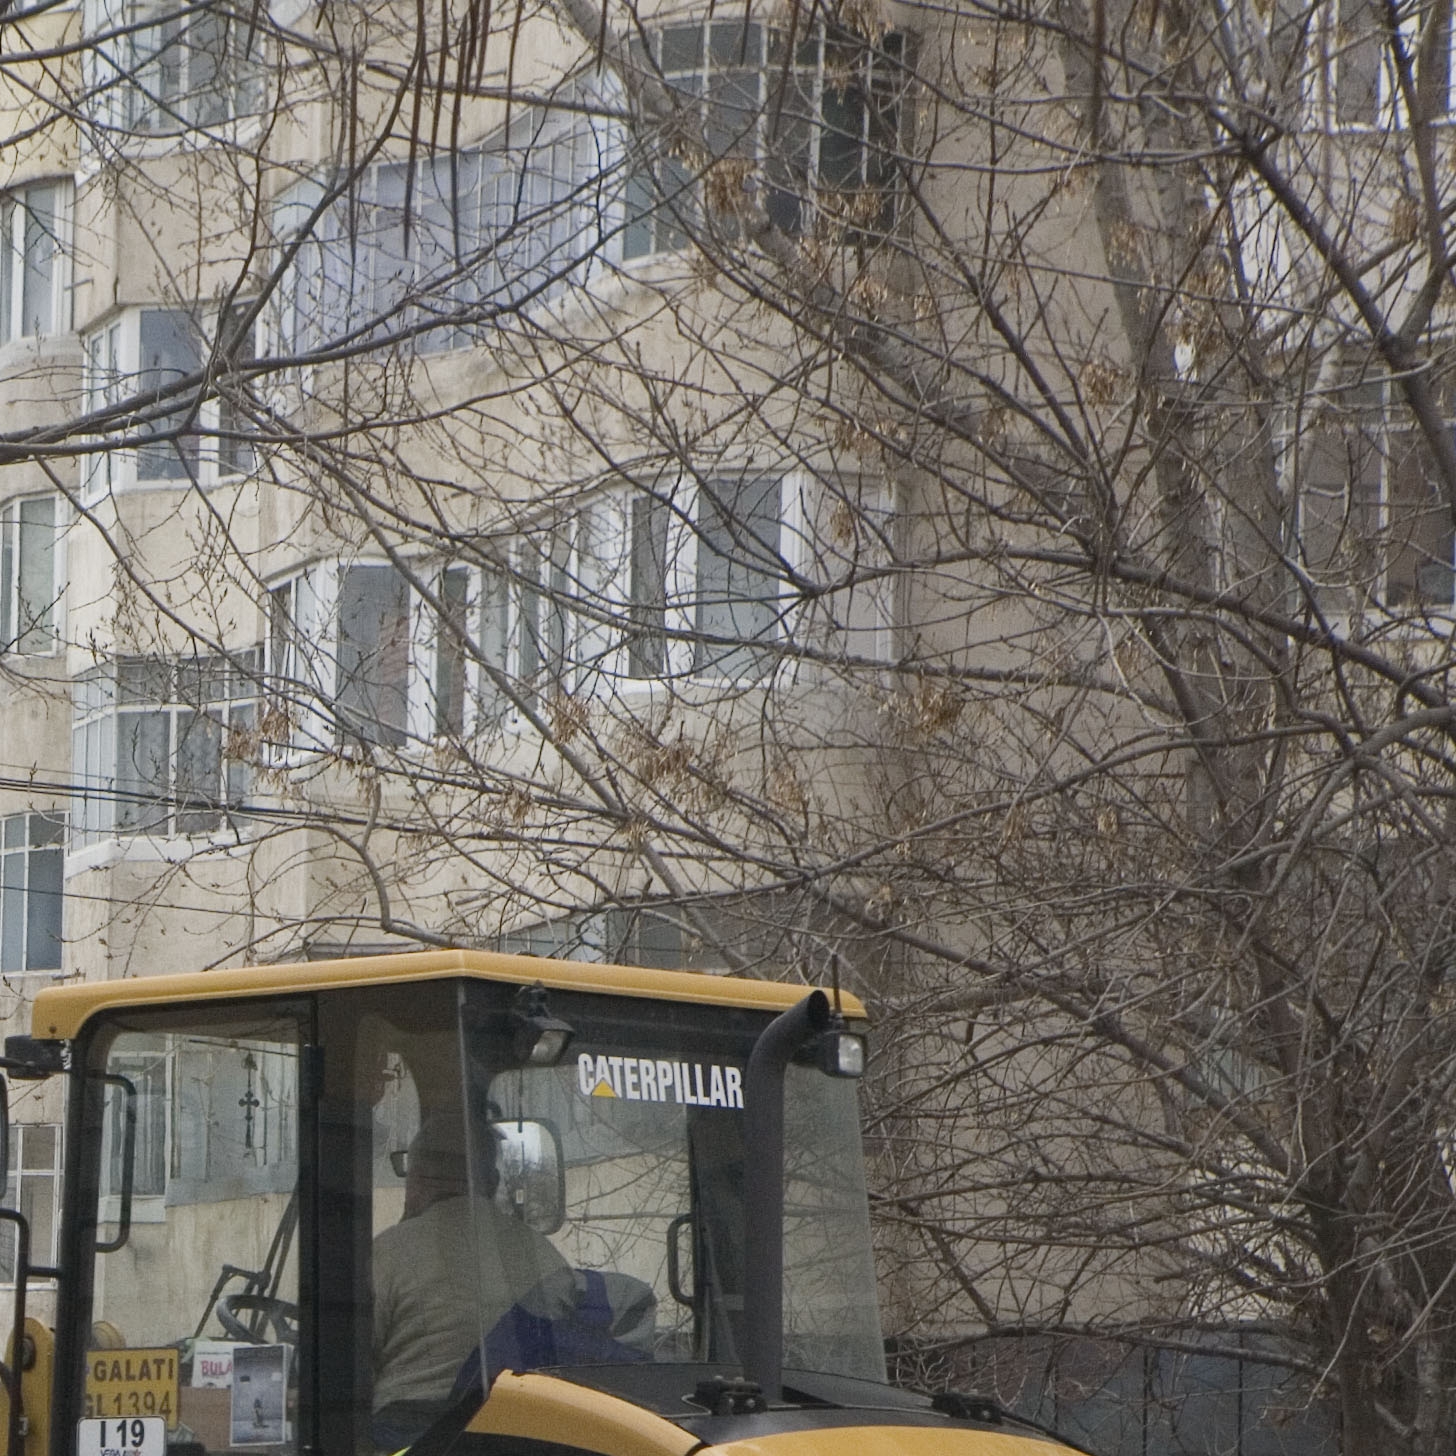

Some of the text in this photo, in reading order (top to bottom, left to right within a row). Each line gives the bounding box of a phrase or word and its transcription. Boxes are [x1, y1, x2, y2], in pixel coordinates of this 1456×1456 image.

[577, 1052, 745, 1109] CATERPILLAR
[94, 1358, 174, 1383] GALATI
[116, 1419, 145, 1448] 19
